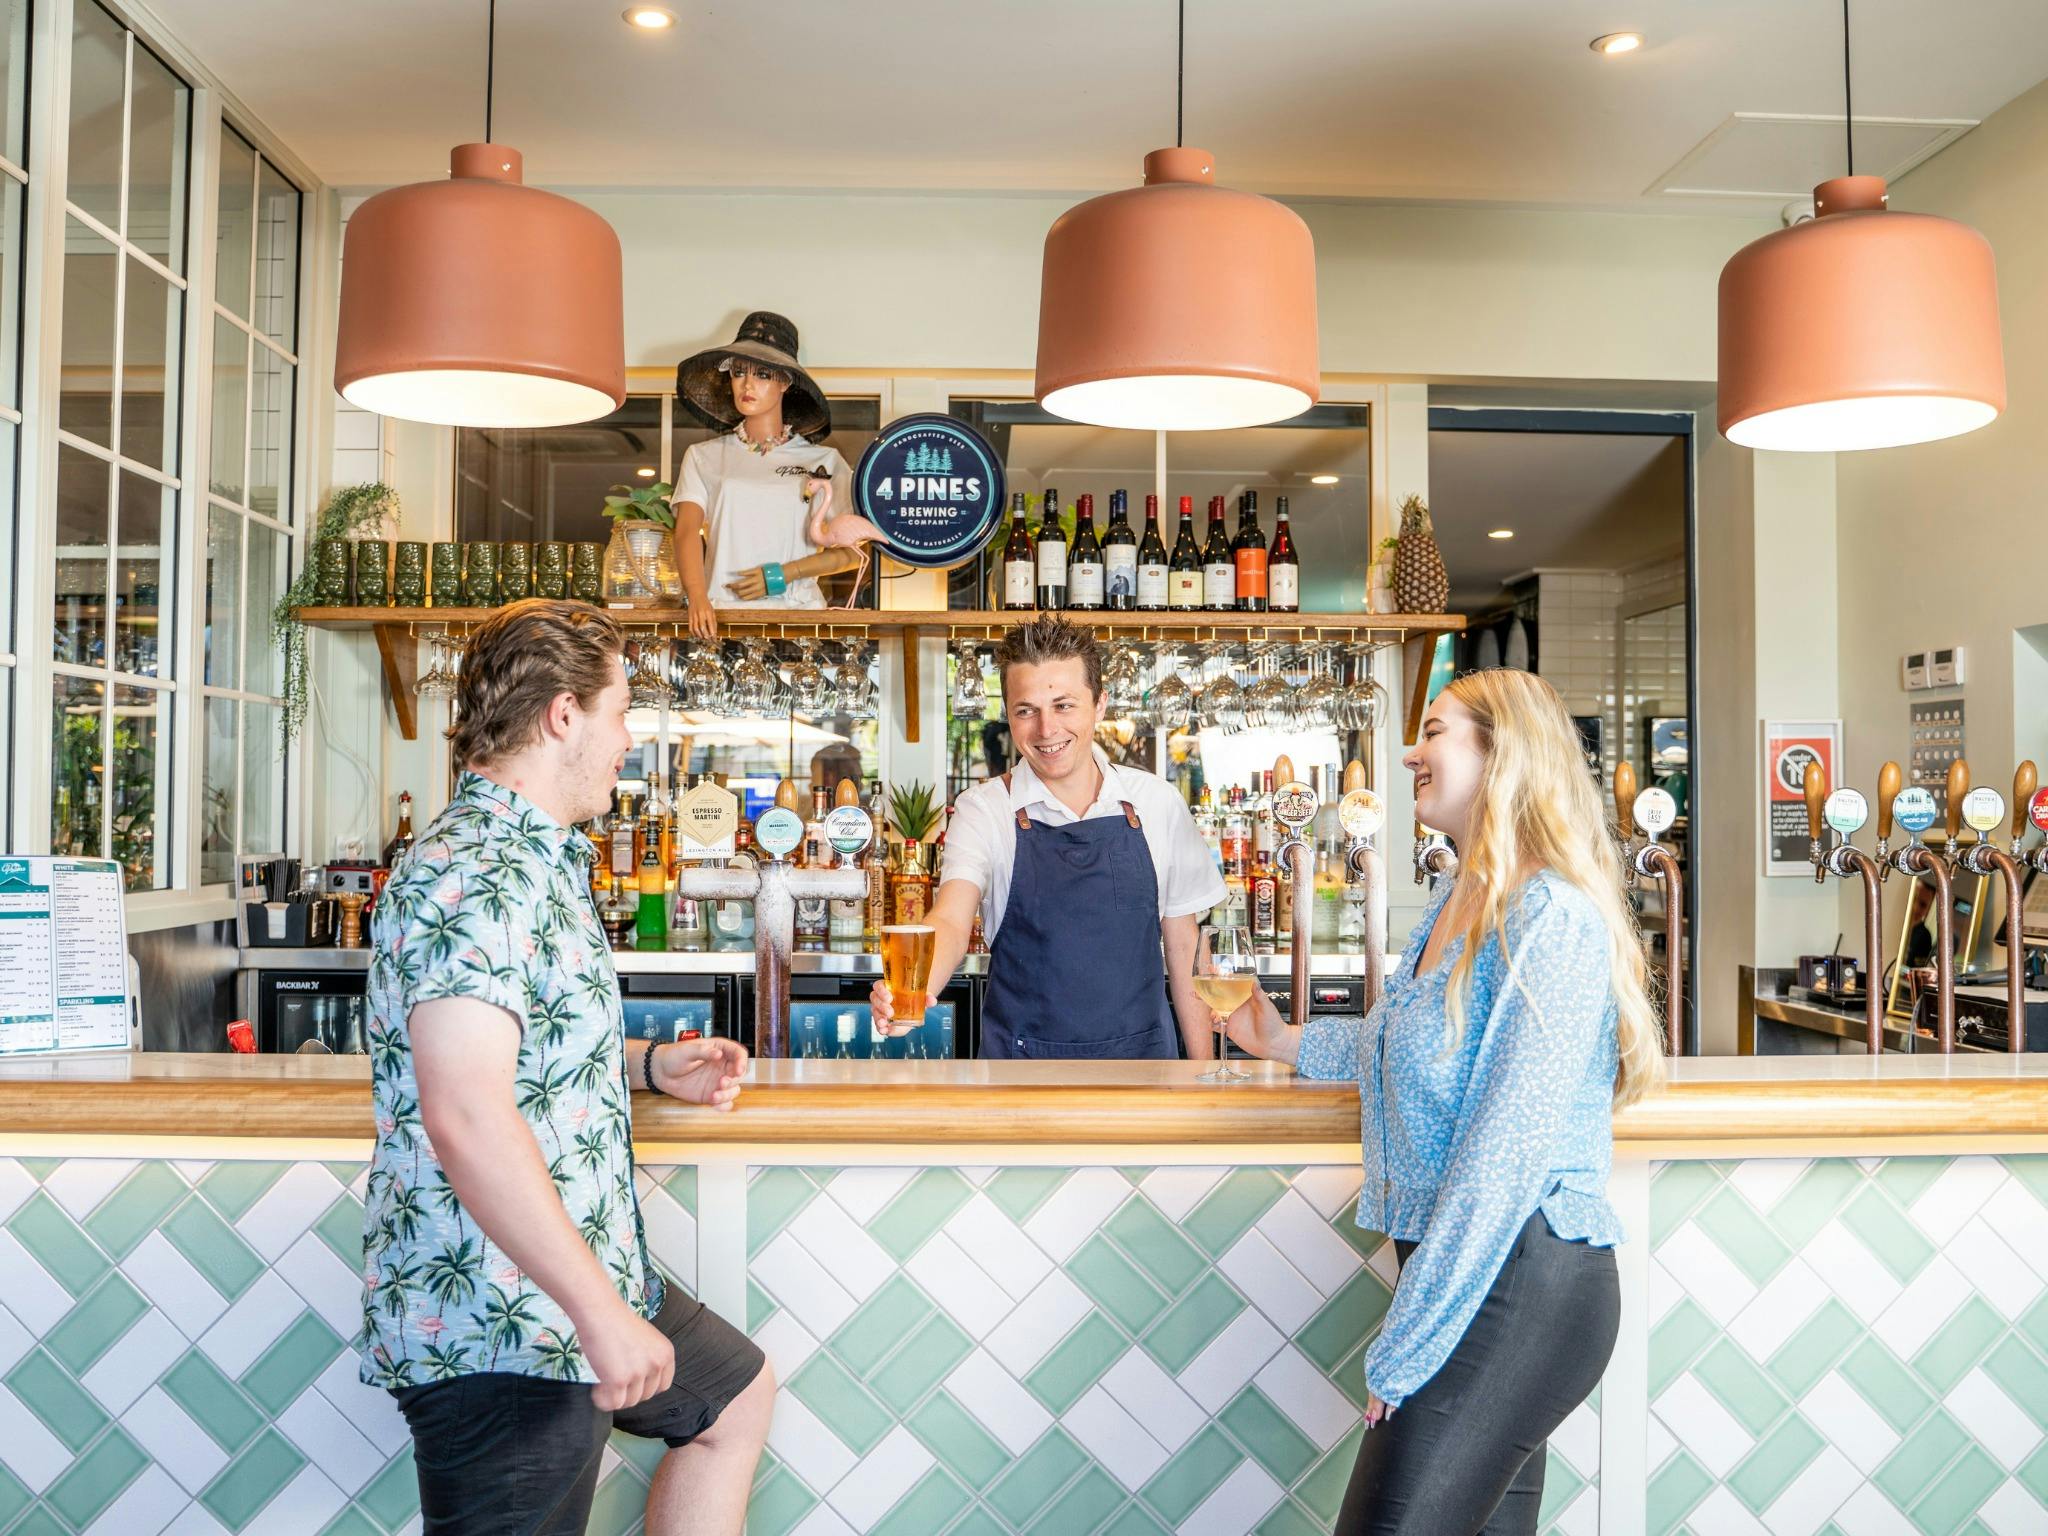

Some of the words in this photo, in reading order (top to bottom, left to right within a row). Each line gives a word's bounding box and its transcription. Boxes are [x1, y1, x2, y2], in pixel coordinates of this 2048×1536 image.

[893, 432, 946, 448] HANDCRAFTED
[949, 437, 966, 450] BEER
[876, 477, 894, 501] 4
[900, 477, 981, 501] PINES
[900, 507, 958, 518] BREWING
[893, 531, 920, 546] BREWED
[923, 532, 963, 547] NATURALLY
[832, 817, 867, 827] Canadian
[840, 826, 857, 836] Club
[276, 981, 311, 990] BACKBAR
[59, 997, 95, 1006] SPARKLING
